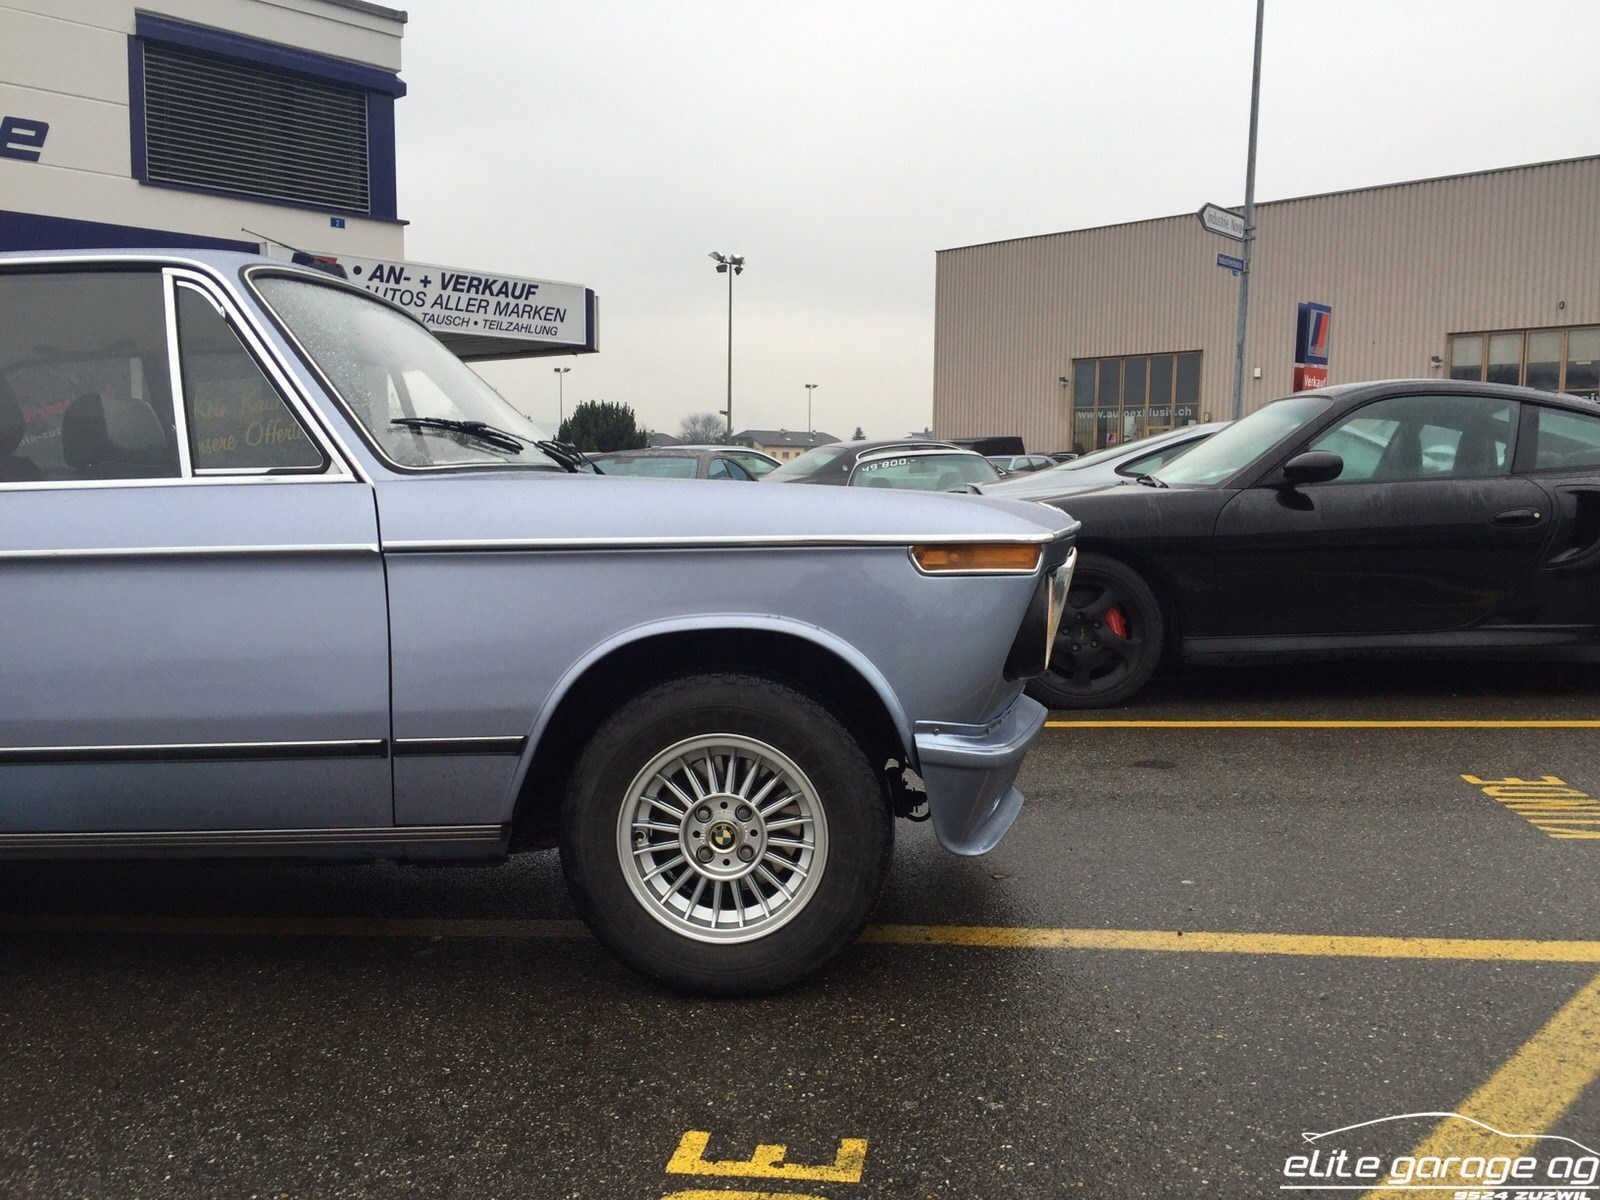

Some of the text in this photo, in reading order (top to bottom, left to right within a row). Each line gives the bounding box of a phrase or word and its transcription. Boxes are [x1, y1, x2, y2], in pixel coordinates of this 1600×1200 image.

[367, 263, 540, 301] AN- + VERKAUF
[366, 285, 567, 323] TOS ALLER MARKEN
[421, 313, 559, 337] TAUSCH TEILZAHLUNG
